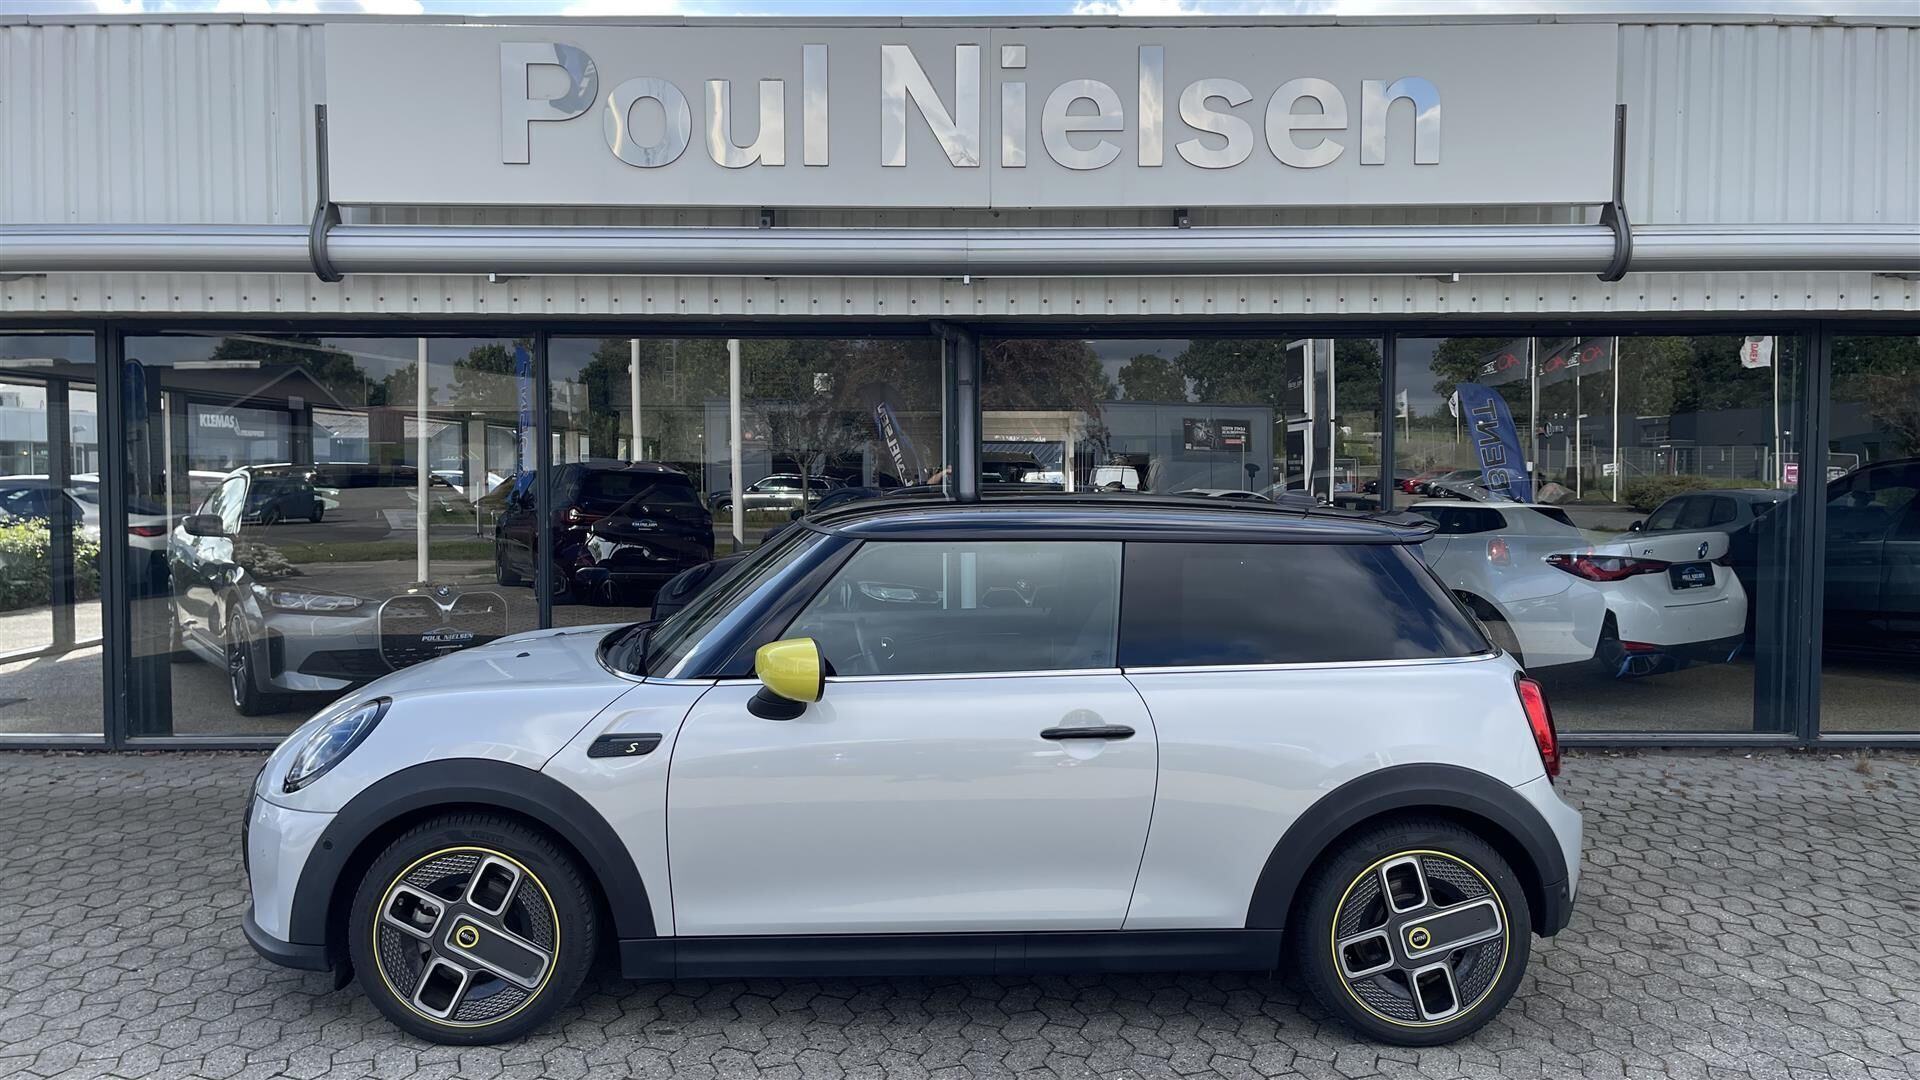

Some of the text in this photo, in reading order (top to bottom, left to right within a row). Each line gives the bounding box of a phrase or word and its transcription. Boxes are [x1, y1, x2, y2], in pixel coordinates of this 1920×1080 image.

[500, 41, 1441, 170] Poul Nielsen
[199, 413, 235, 428] KLEMAS
[625, 742, 639, 753] S
